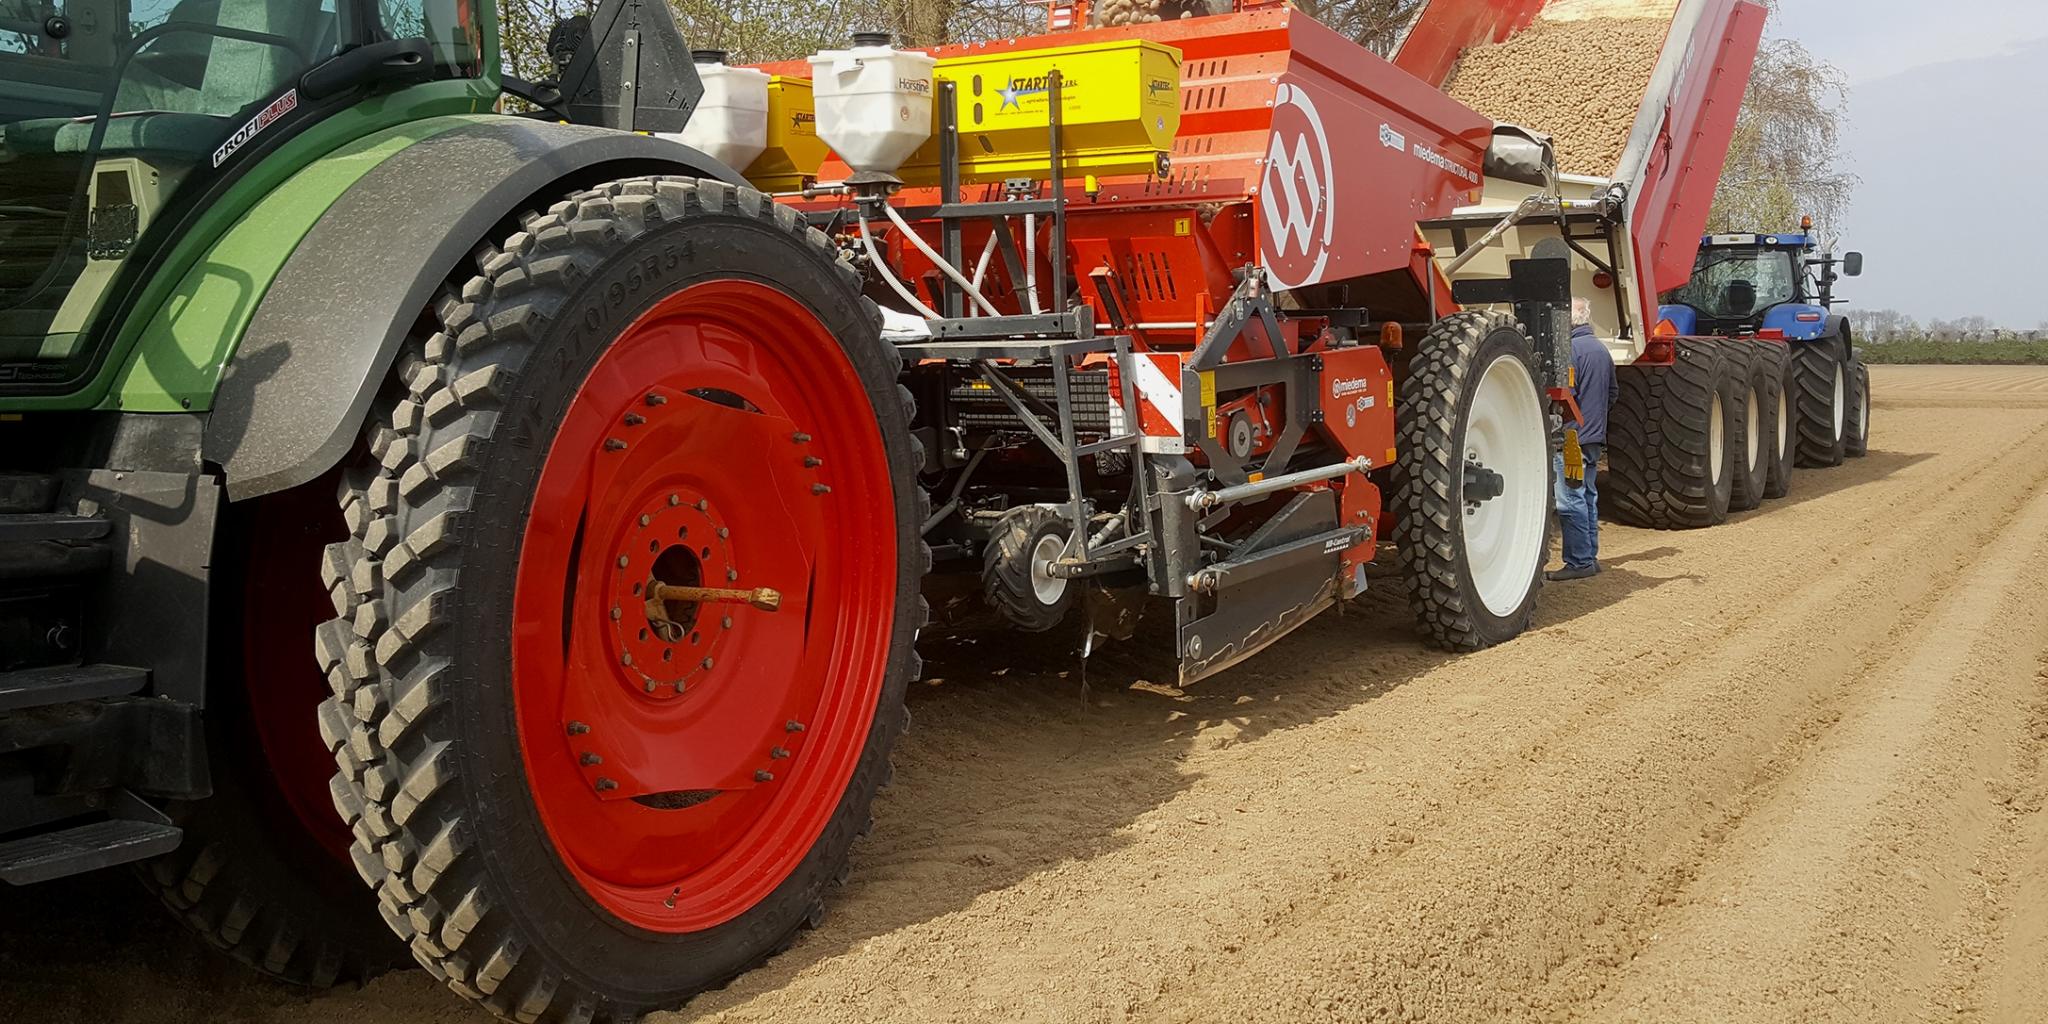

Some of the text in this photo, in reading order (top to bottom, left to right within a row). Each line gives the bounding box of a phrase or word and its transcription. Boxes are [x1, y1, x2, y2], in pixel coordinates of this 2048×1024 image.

[899, 78, 929, 93] Horstine
[1413, 142, 1445, 169] miedema
[1444, 157, 1469, 181] STRUCTURAL
[1341, 377, 1367, 392] miedema
